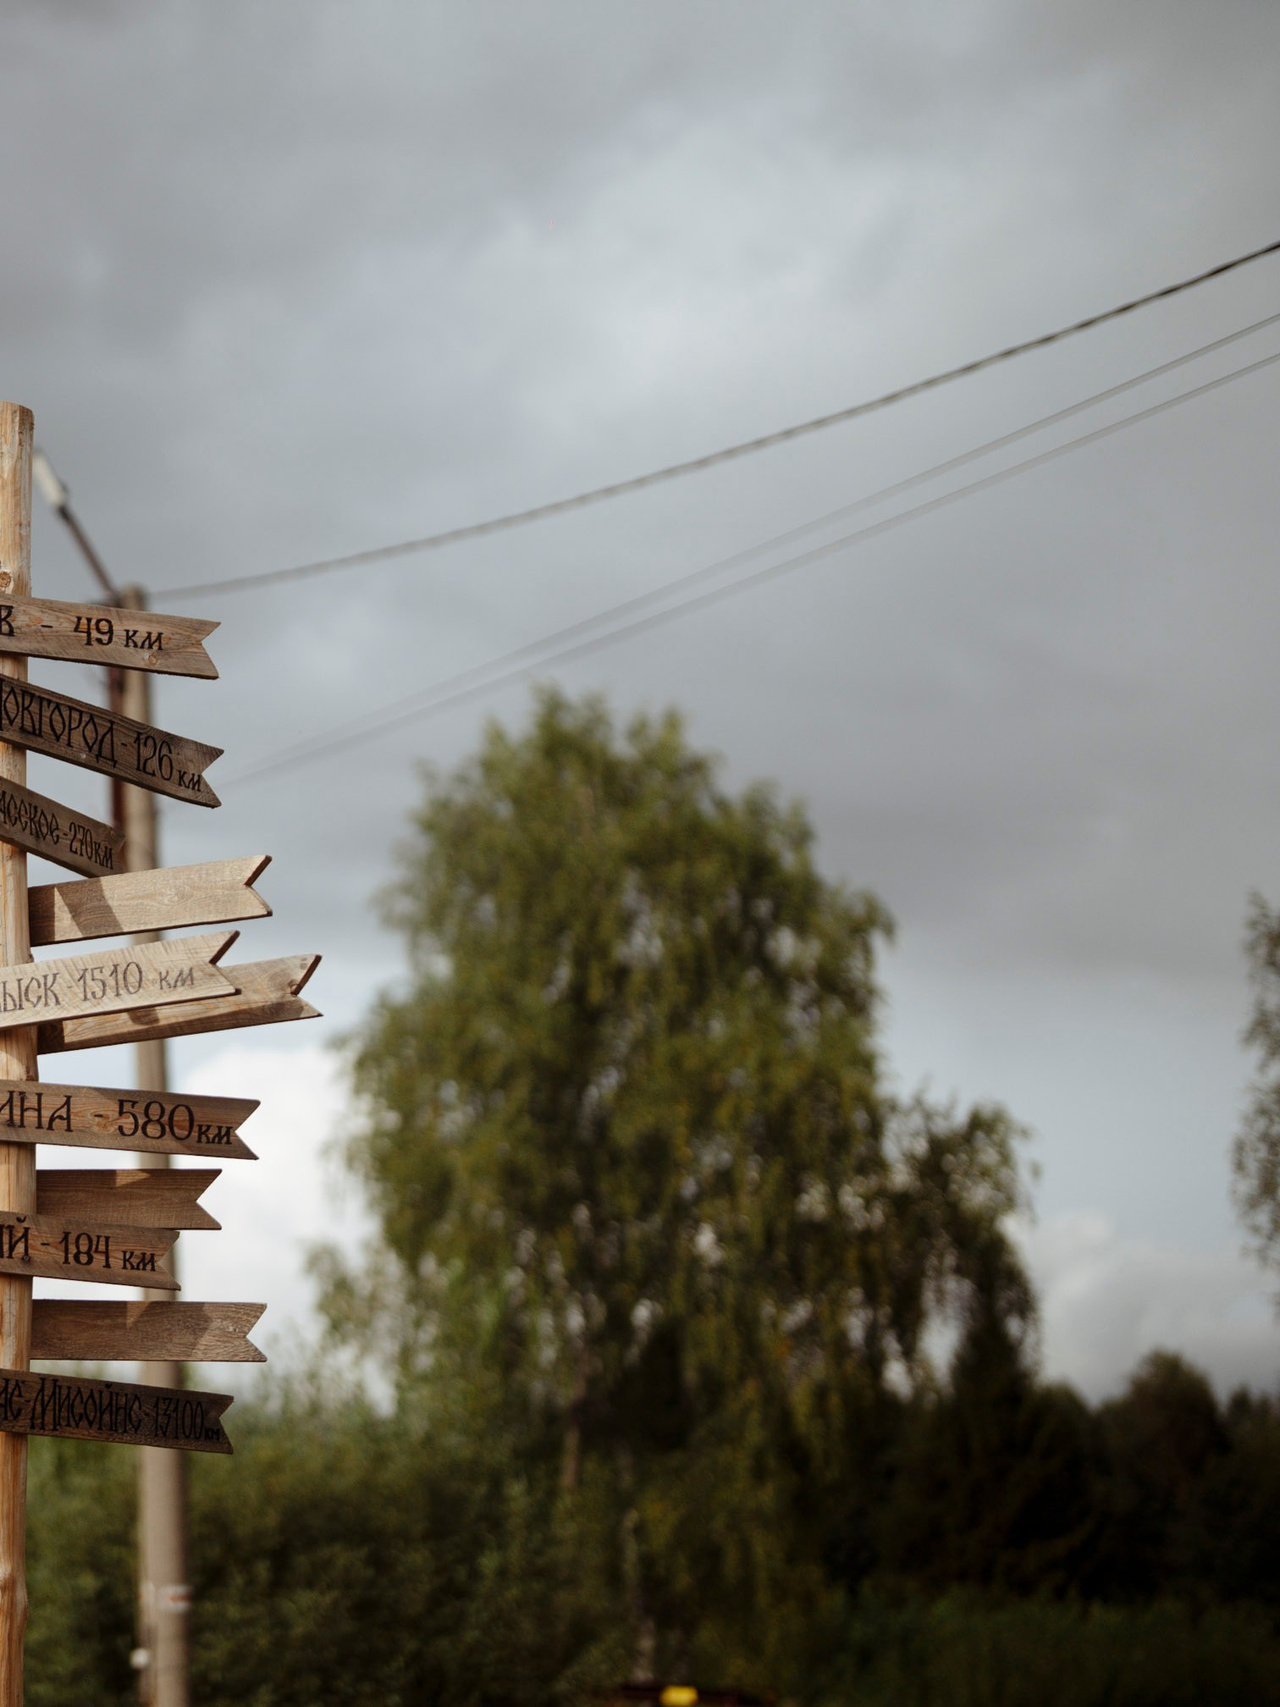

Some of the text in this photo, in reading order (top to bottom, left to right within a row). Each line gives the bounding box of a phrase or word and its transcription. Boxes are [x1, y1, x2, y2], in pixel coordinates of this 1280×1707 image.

[74, 616, 114, 646] 49
[123, 627, 165, 652] км
[158, 968, 195, 990] км
[57, 1230, 111, 1269] 184
[121, 1250, 157, 1273] км
